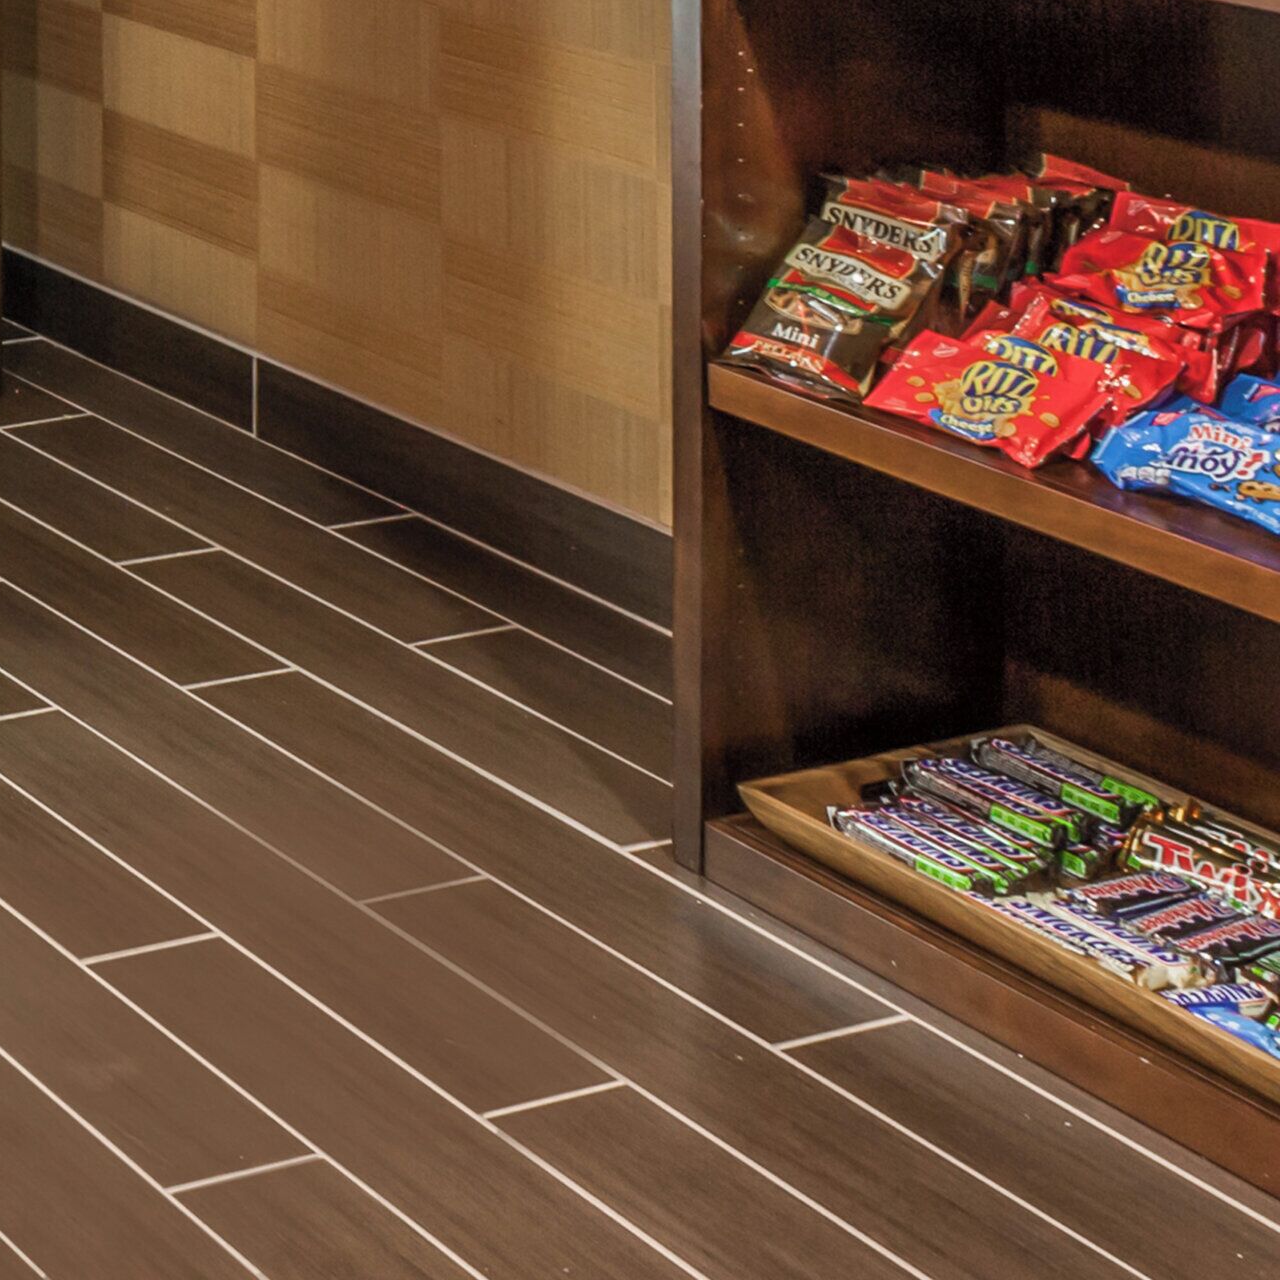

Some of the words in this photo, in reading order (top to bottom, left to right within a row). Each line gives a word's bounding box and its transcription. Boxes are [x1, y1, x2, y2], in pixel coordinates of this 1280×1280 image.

[771, 321, 820, 349] Mini
[962, 360, 1038, 398] RITZ
[1189, 422, 1253, 451] Mini
